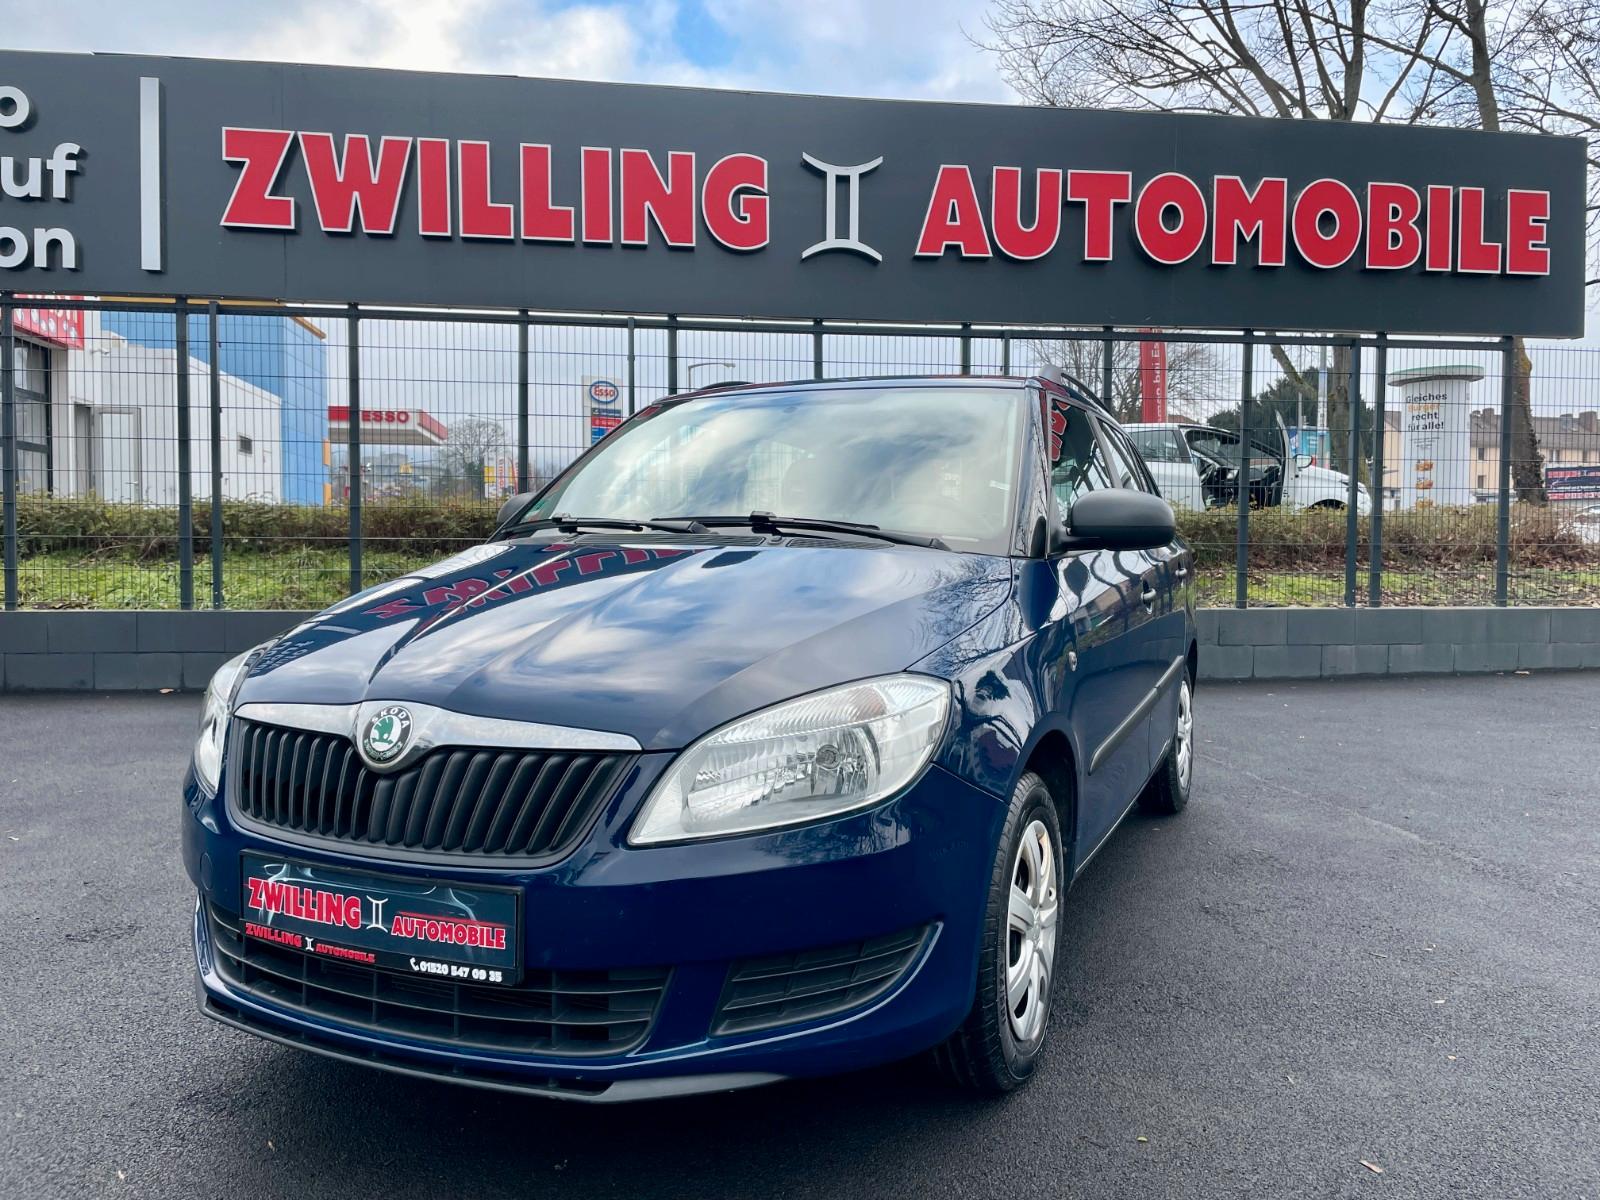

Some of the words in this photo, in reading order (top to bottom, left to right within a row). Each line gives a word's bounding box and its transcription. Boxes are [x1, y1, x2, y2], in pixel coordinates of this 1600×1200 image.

[0, 142, 81, 199] uf
[221, 127, 769, 251] ZWILLING
[915, 164, 1551, 277] AUTOMOBILE
[362, 411, 409, 424] ESSO
[248, 877, 361, 930] ZWILLING
[391, 916, 506, 950] AUTOMOBILE
[245, 922, 302, 948] ZWILLING
[316, 944, 375, 964] AUTOMOBILE
